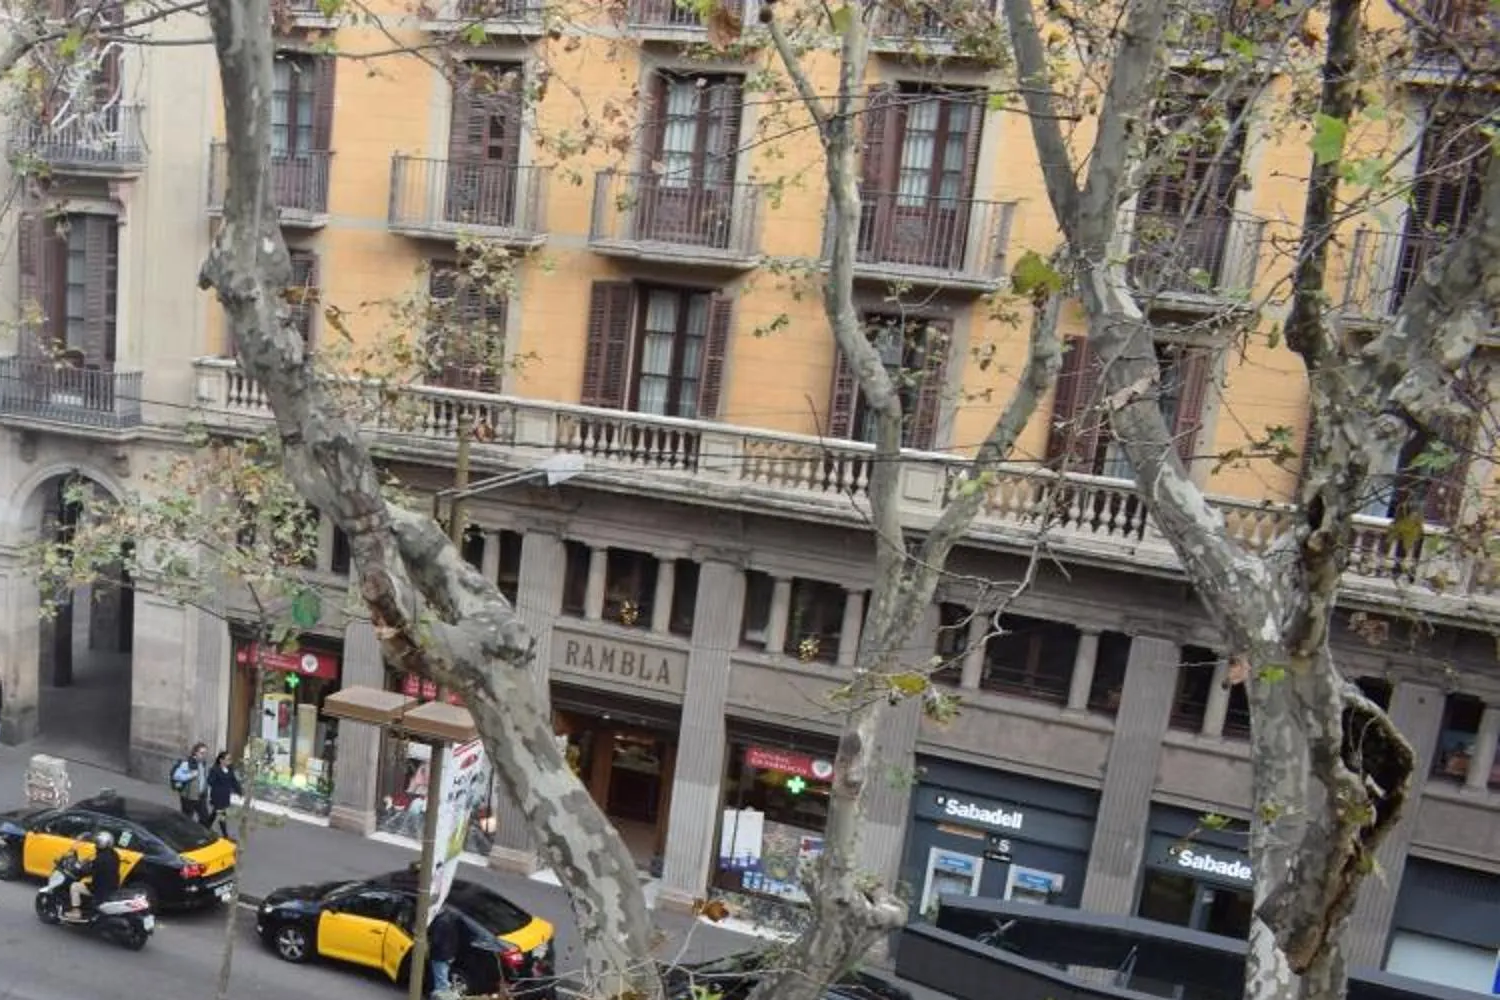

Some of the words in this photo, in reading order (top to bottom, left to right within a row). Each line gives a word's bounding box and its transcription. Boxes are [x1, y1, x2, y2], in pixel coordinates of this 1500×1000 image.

[564, 639, 670, 685] RAMBLA
[945, 798, 1023, 829] Sabadell
[1178, 850, 1253, 881] Sabade
